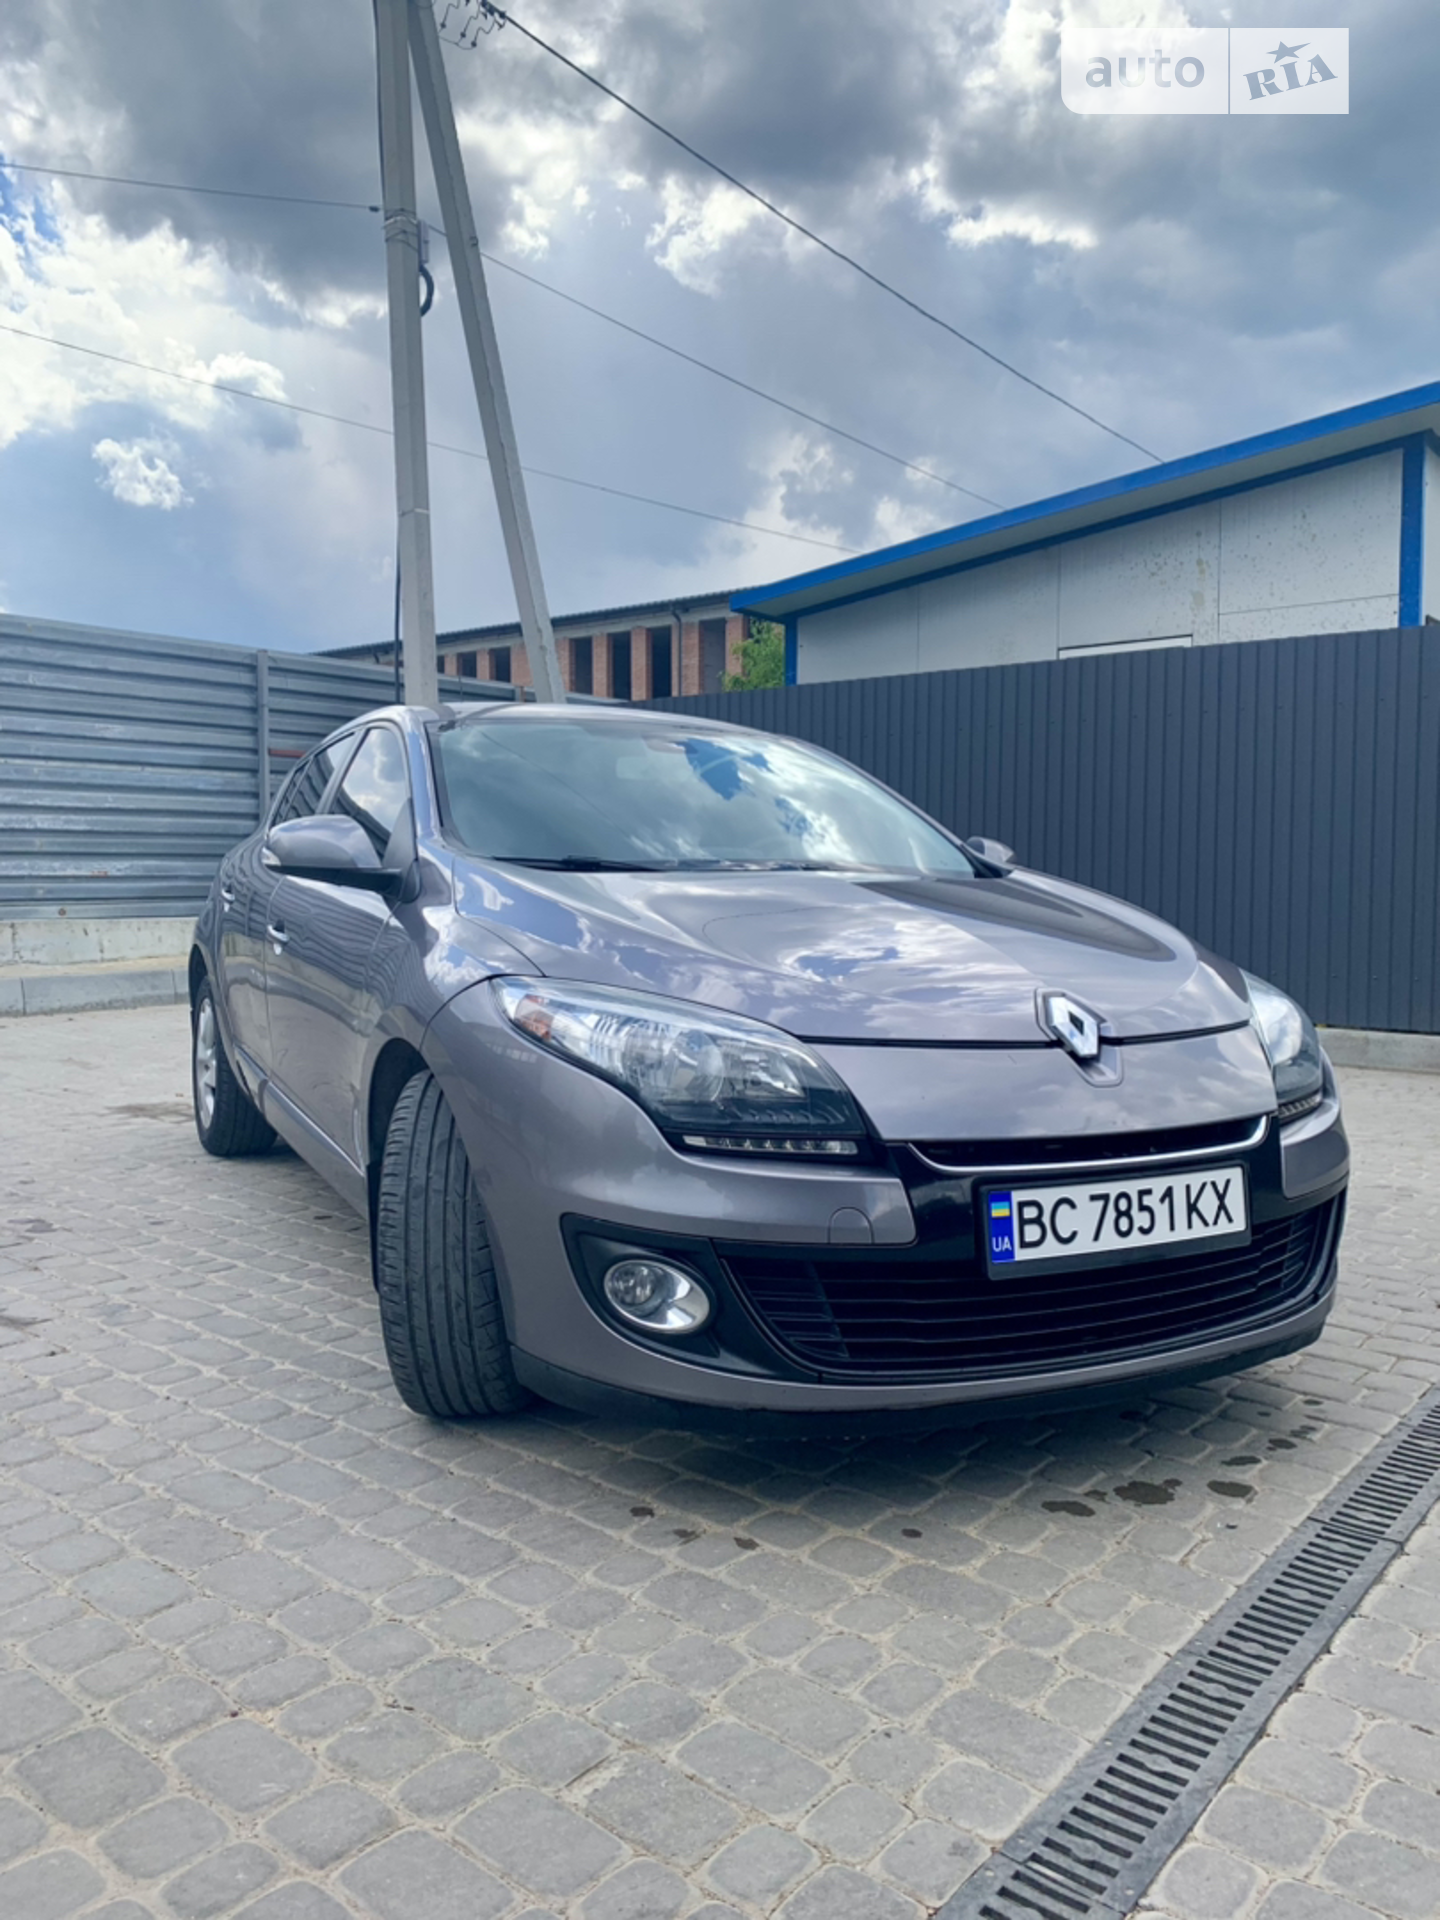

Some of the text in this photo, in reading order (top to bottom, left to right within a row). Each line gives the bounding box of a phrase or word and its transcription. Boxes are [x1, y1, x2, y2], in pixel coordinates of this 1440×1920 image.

[1016, 1197, 1078, 1249] BC
[1089, 1185, 1175, 1242] 7851
[992, 1236, 1012, 1252] UA
